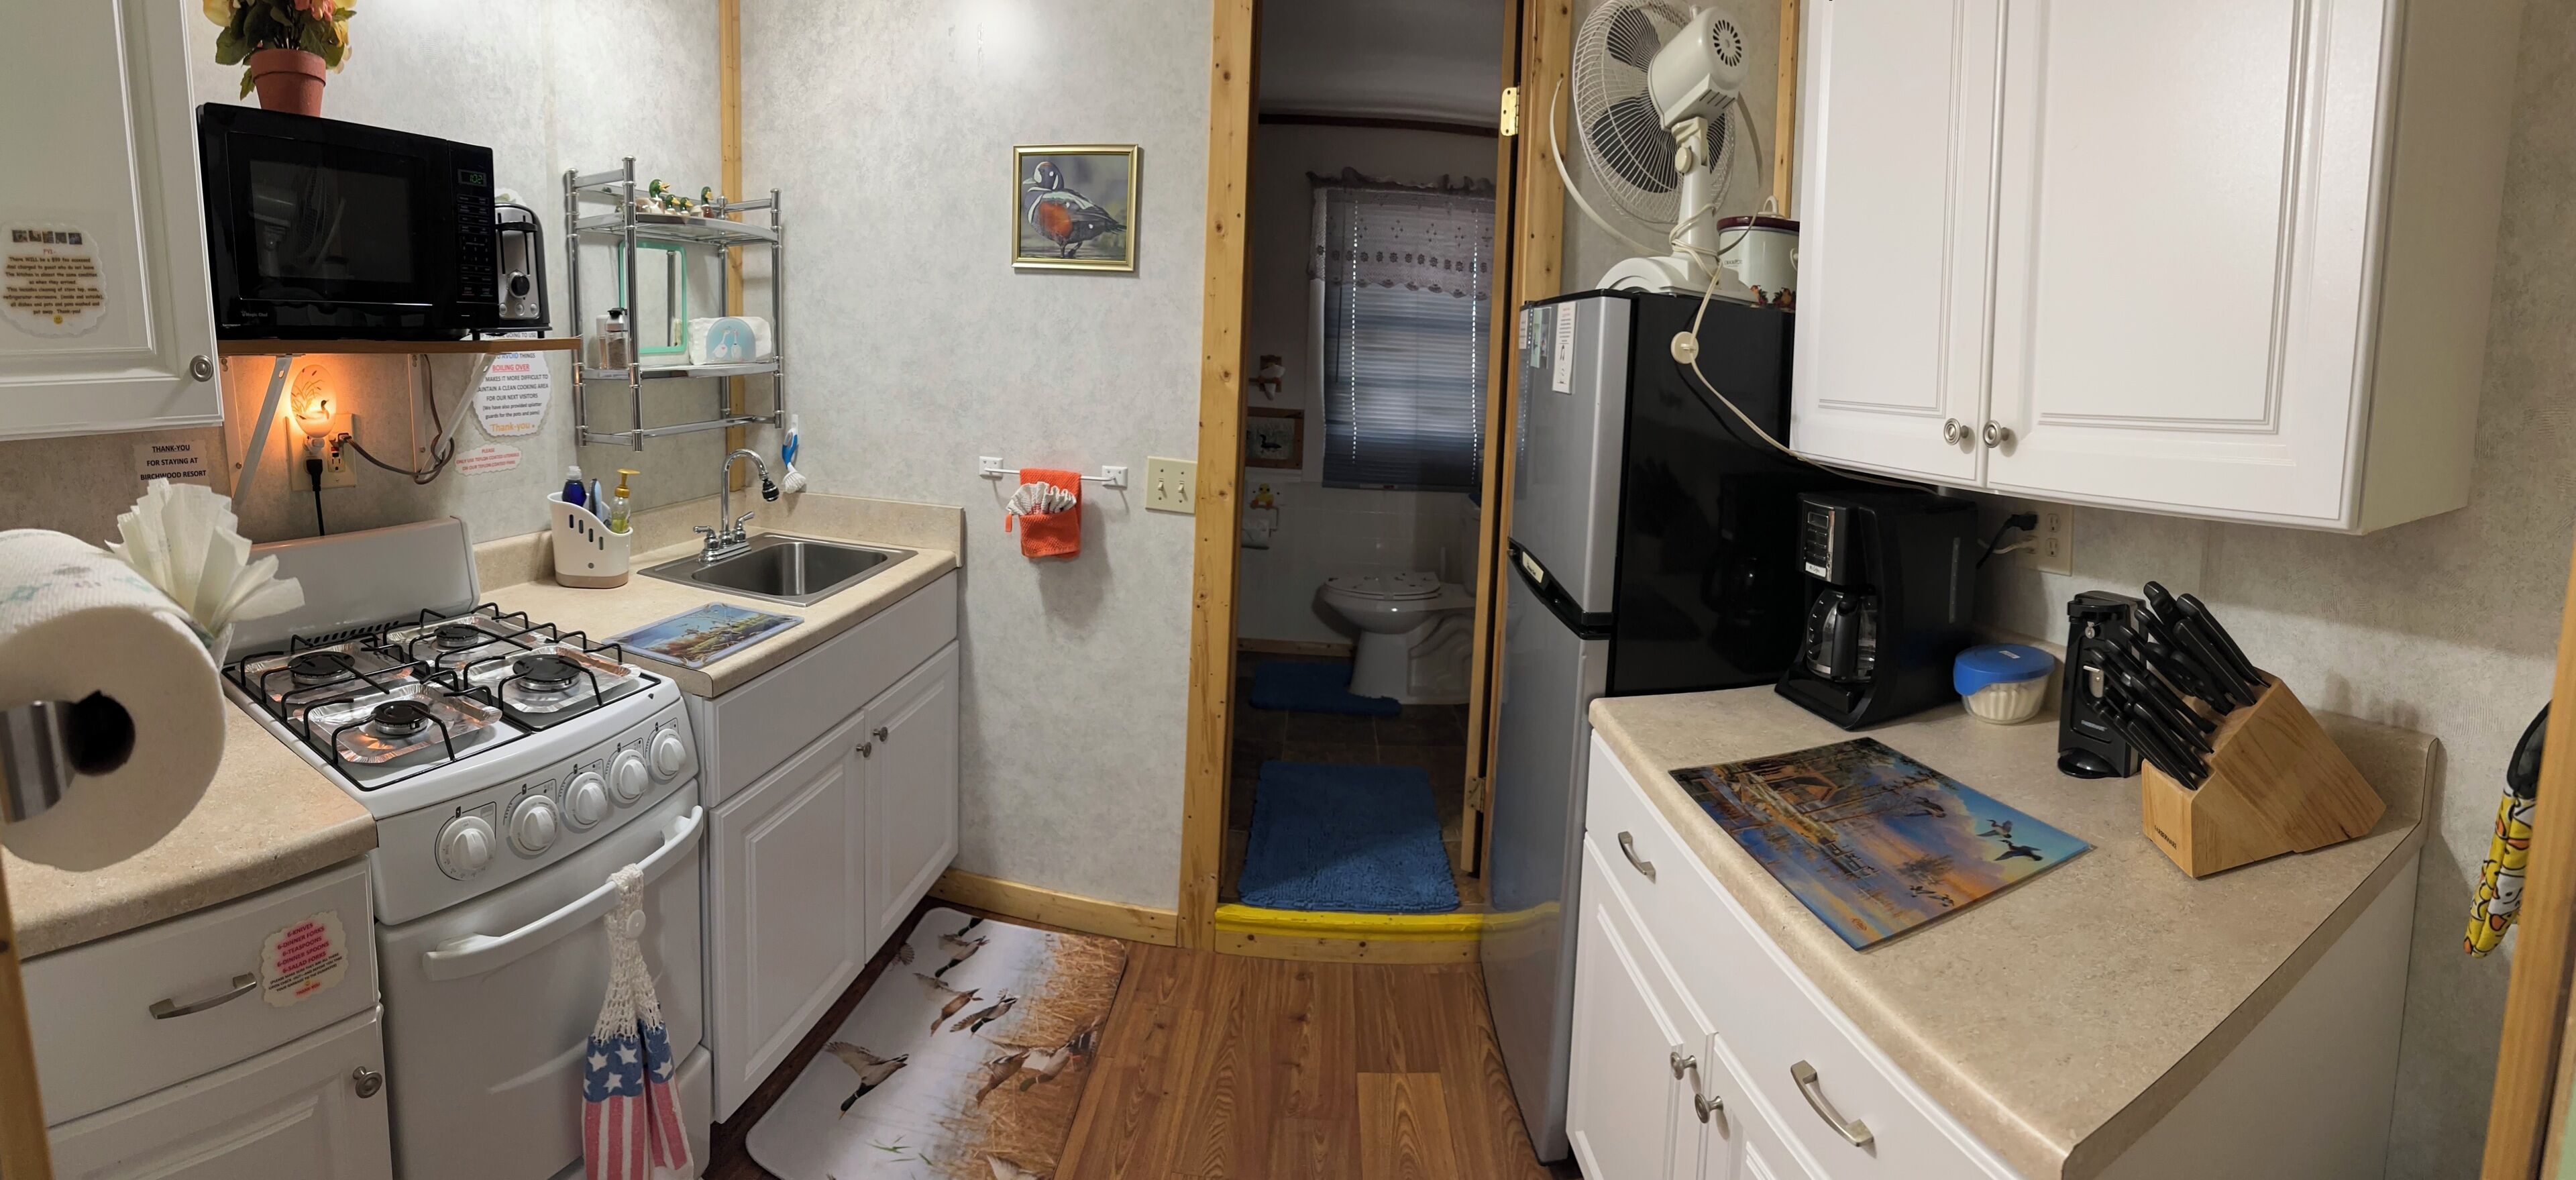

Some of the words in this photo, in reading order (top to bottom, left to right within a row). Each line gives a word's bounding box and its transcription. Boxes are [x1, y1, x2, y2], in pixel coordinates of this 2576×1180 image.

[152, 444, 191, 453] THANK-YOU
[162, 458, 189, 466] STAYING
[140, 472, 182, 480] BIRCHWOOD
[277, 934, 305, 950] 6-DINNER
[307, 926, 325, 938] FORKS
[287, 923, 313, 937] 6-KNIVES
[277, 952, 305, 967] 6-DINNER
[306, 941, 329, 955] SPOONS
[282, 936, 322, 957] 6-TEASPOONS
[283, 960, 307, 973] 6-SALAD
[308, 951, 326, 963] FORKS
